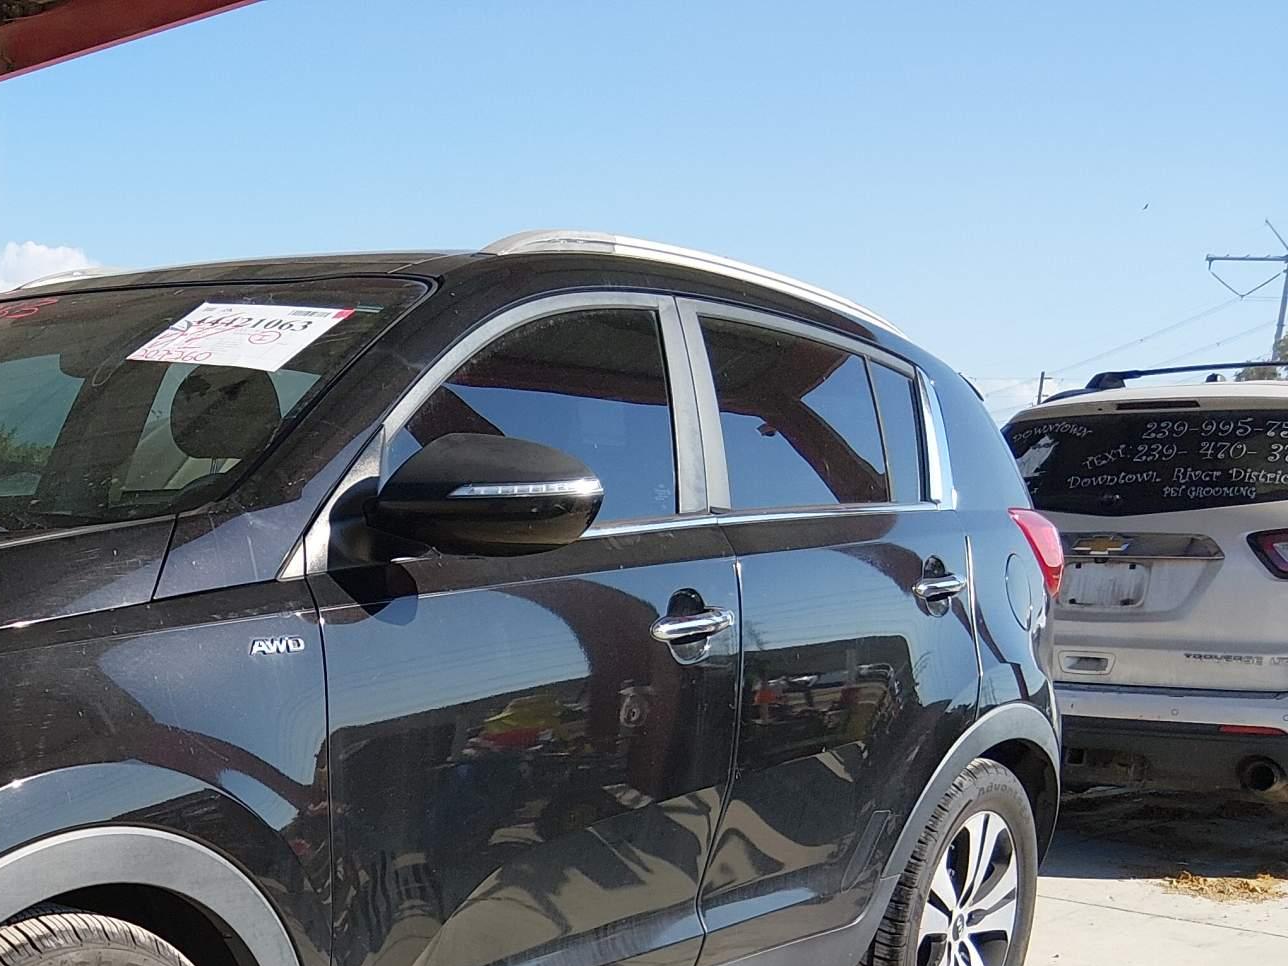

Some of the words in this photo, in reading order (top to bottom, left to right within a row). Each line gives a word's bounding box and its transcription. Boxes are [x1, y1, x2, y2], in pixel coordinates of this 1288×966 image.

[194, 315, 313, 332] 44421063
[1173, 467, 1222, 483] River
[1163, 486, 1186, 497] PET
[1187, 486, 1257, 499] GROOMING
[249, 636, 305, 655] AWD
